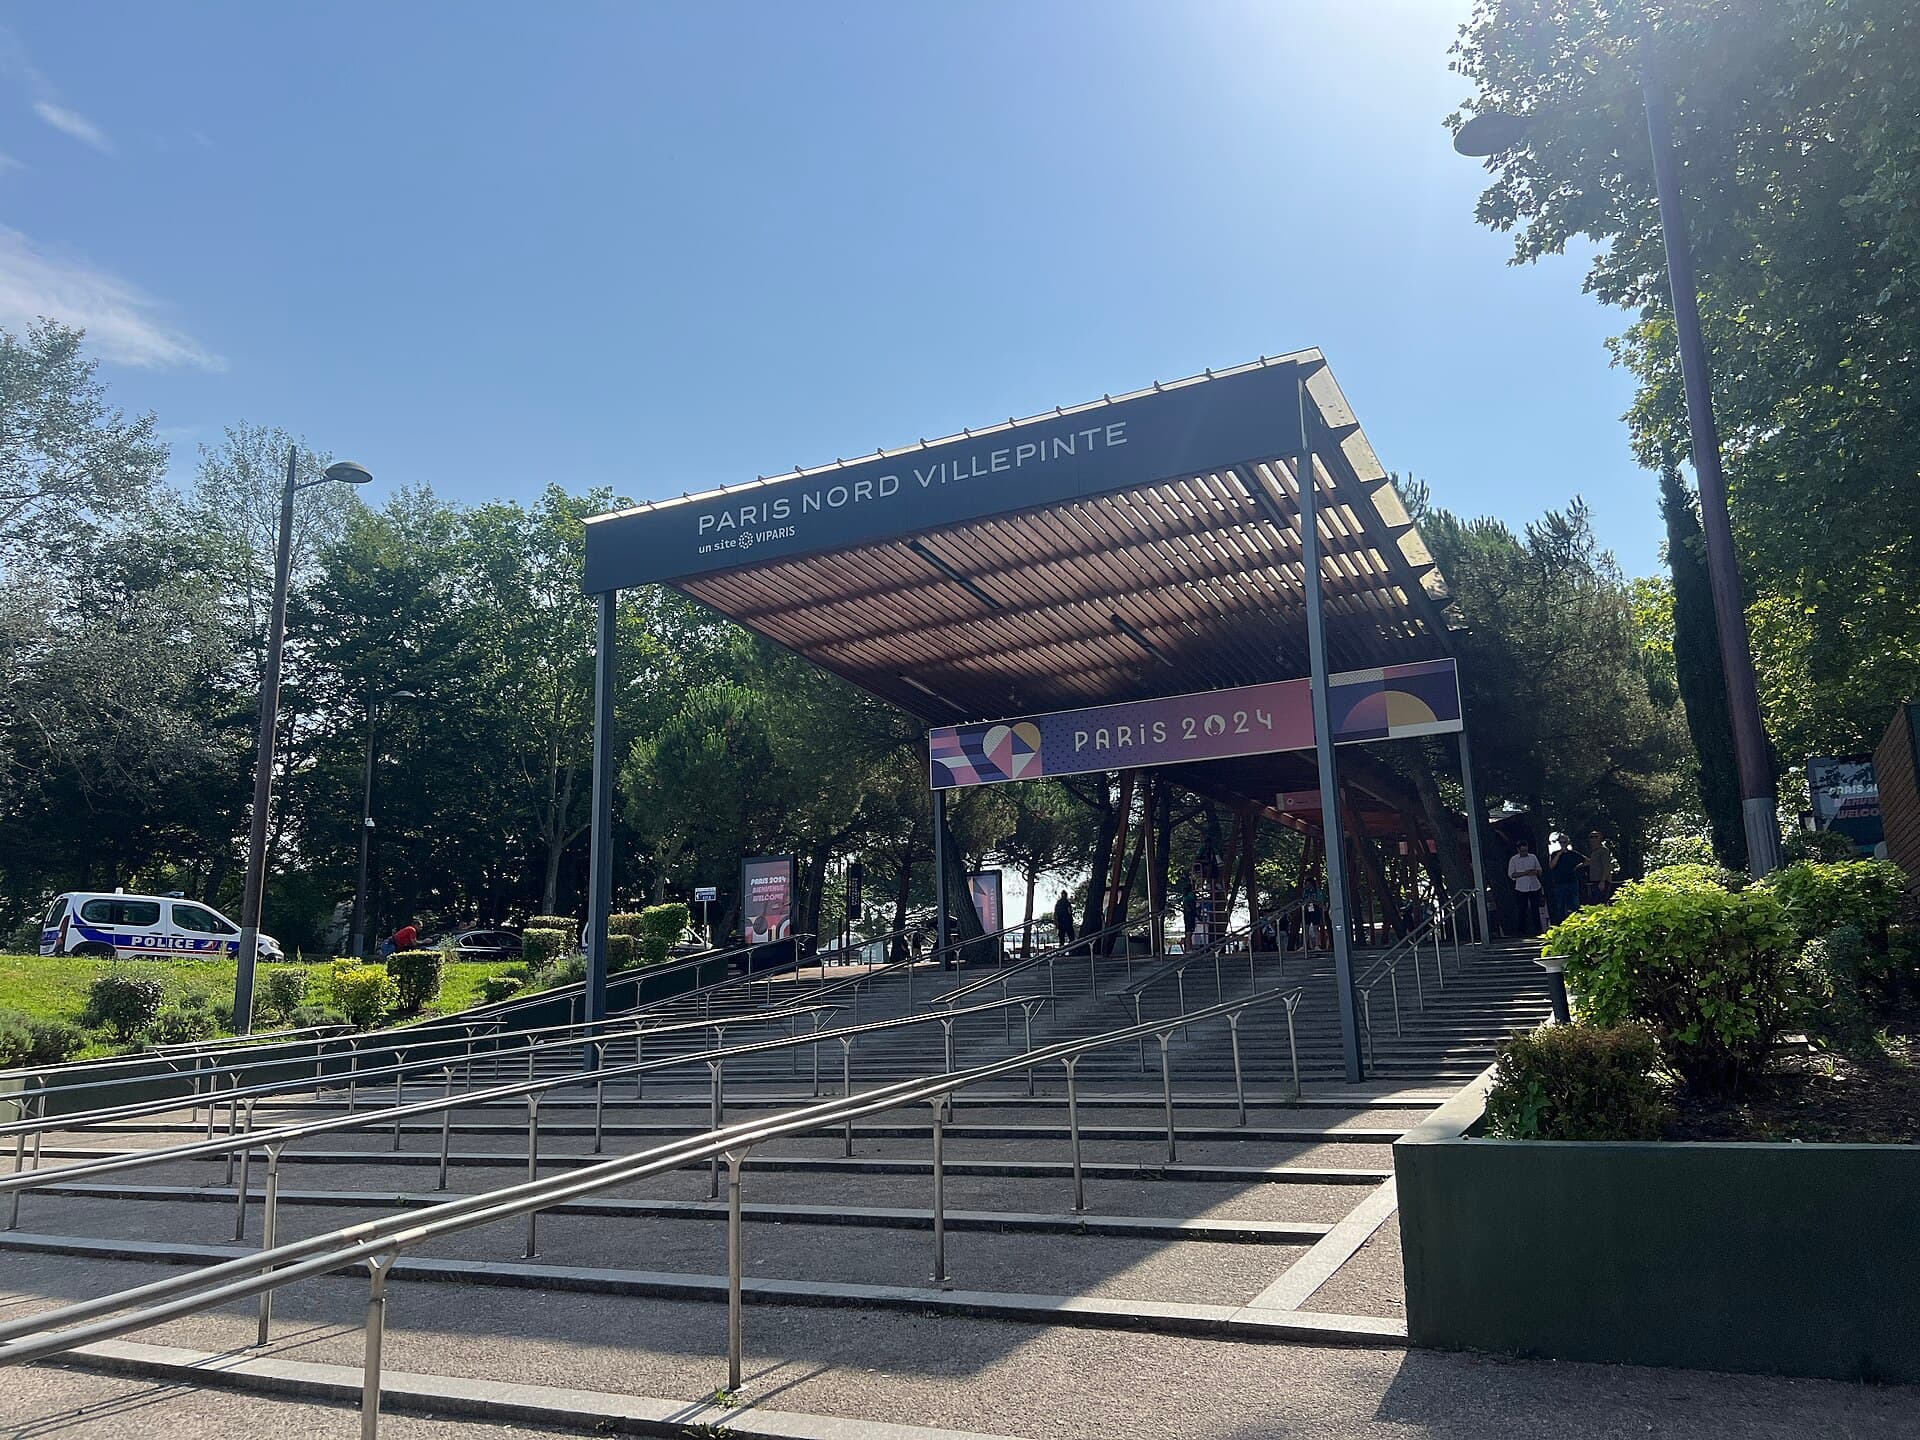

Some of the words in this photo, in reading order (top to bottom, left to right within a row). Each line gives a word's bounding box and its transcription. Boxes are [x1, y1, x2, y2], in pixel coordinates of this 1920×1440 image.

[698, 498, 791, 536] PARIS
[802, 475, 899, 514] NORD
[913, 420, 1128, 488] VILLEPINTE
[698, 539, 712, 554] un
[713, 535, 737, 551] site
[755, 525, 796, 543] VIPARIS
[1181, 709, 1273, 741] 2024
[131, 936, 194, 949] POLICE
